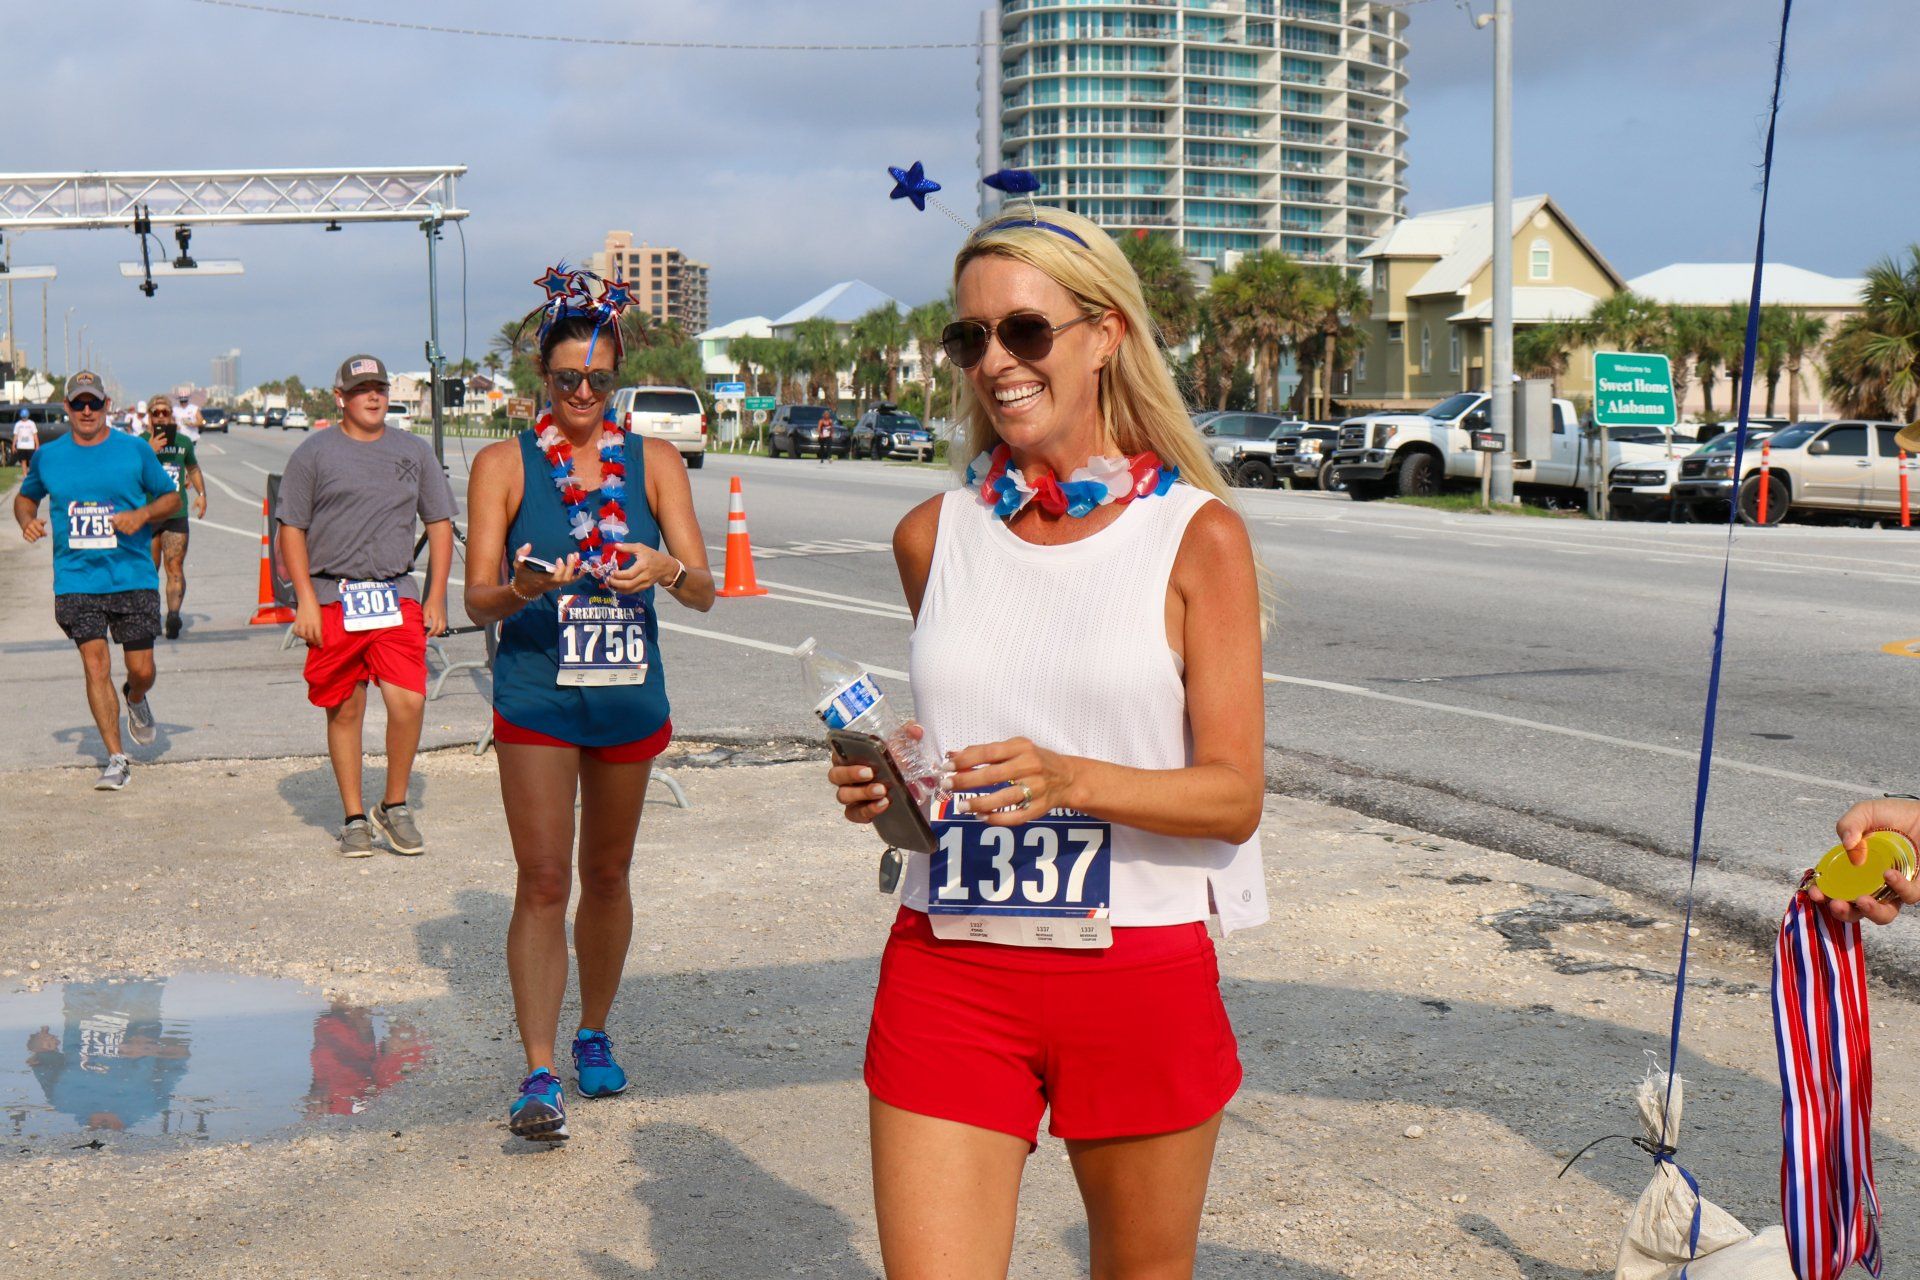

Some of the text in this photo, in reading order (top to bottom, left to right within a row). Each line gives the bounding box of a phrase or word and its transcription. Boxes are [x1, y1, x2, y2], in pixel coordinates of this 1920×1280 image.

[1614, 364, 1643, 373] Welcome
[1598, 378, 1669, 394] Sweet Home
[1607, 399, 1665, 415] Alabama
[70, 515, 114, 536] 1755
[343, 590, 398, 616] 1301
[563, 624, 644, 663] 1756
[938, 826, 1104, 903] 1337
